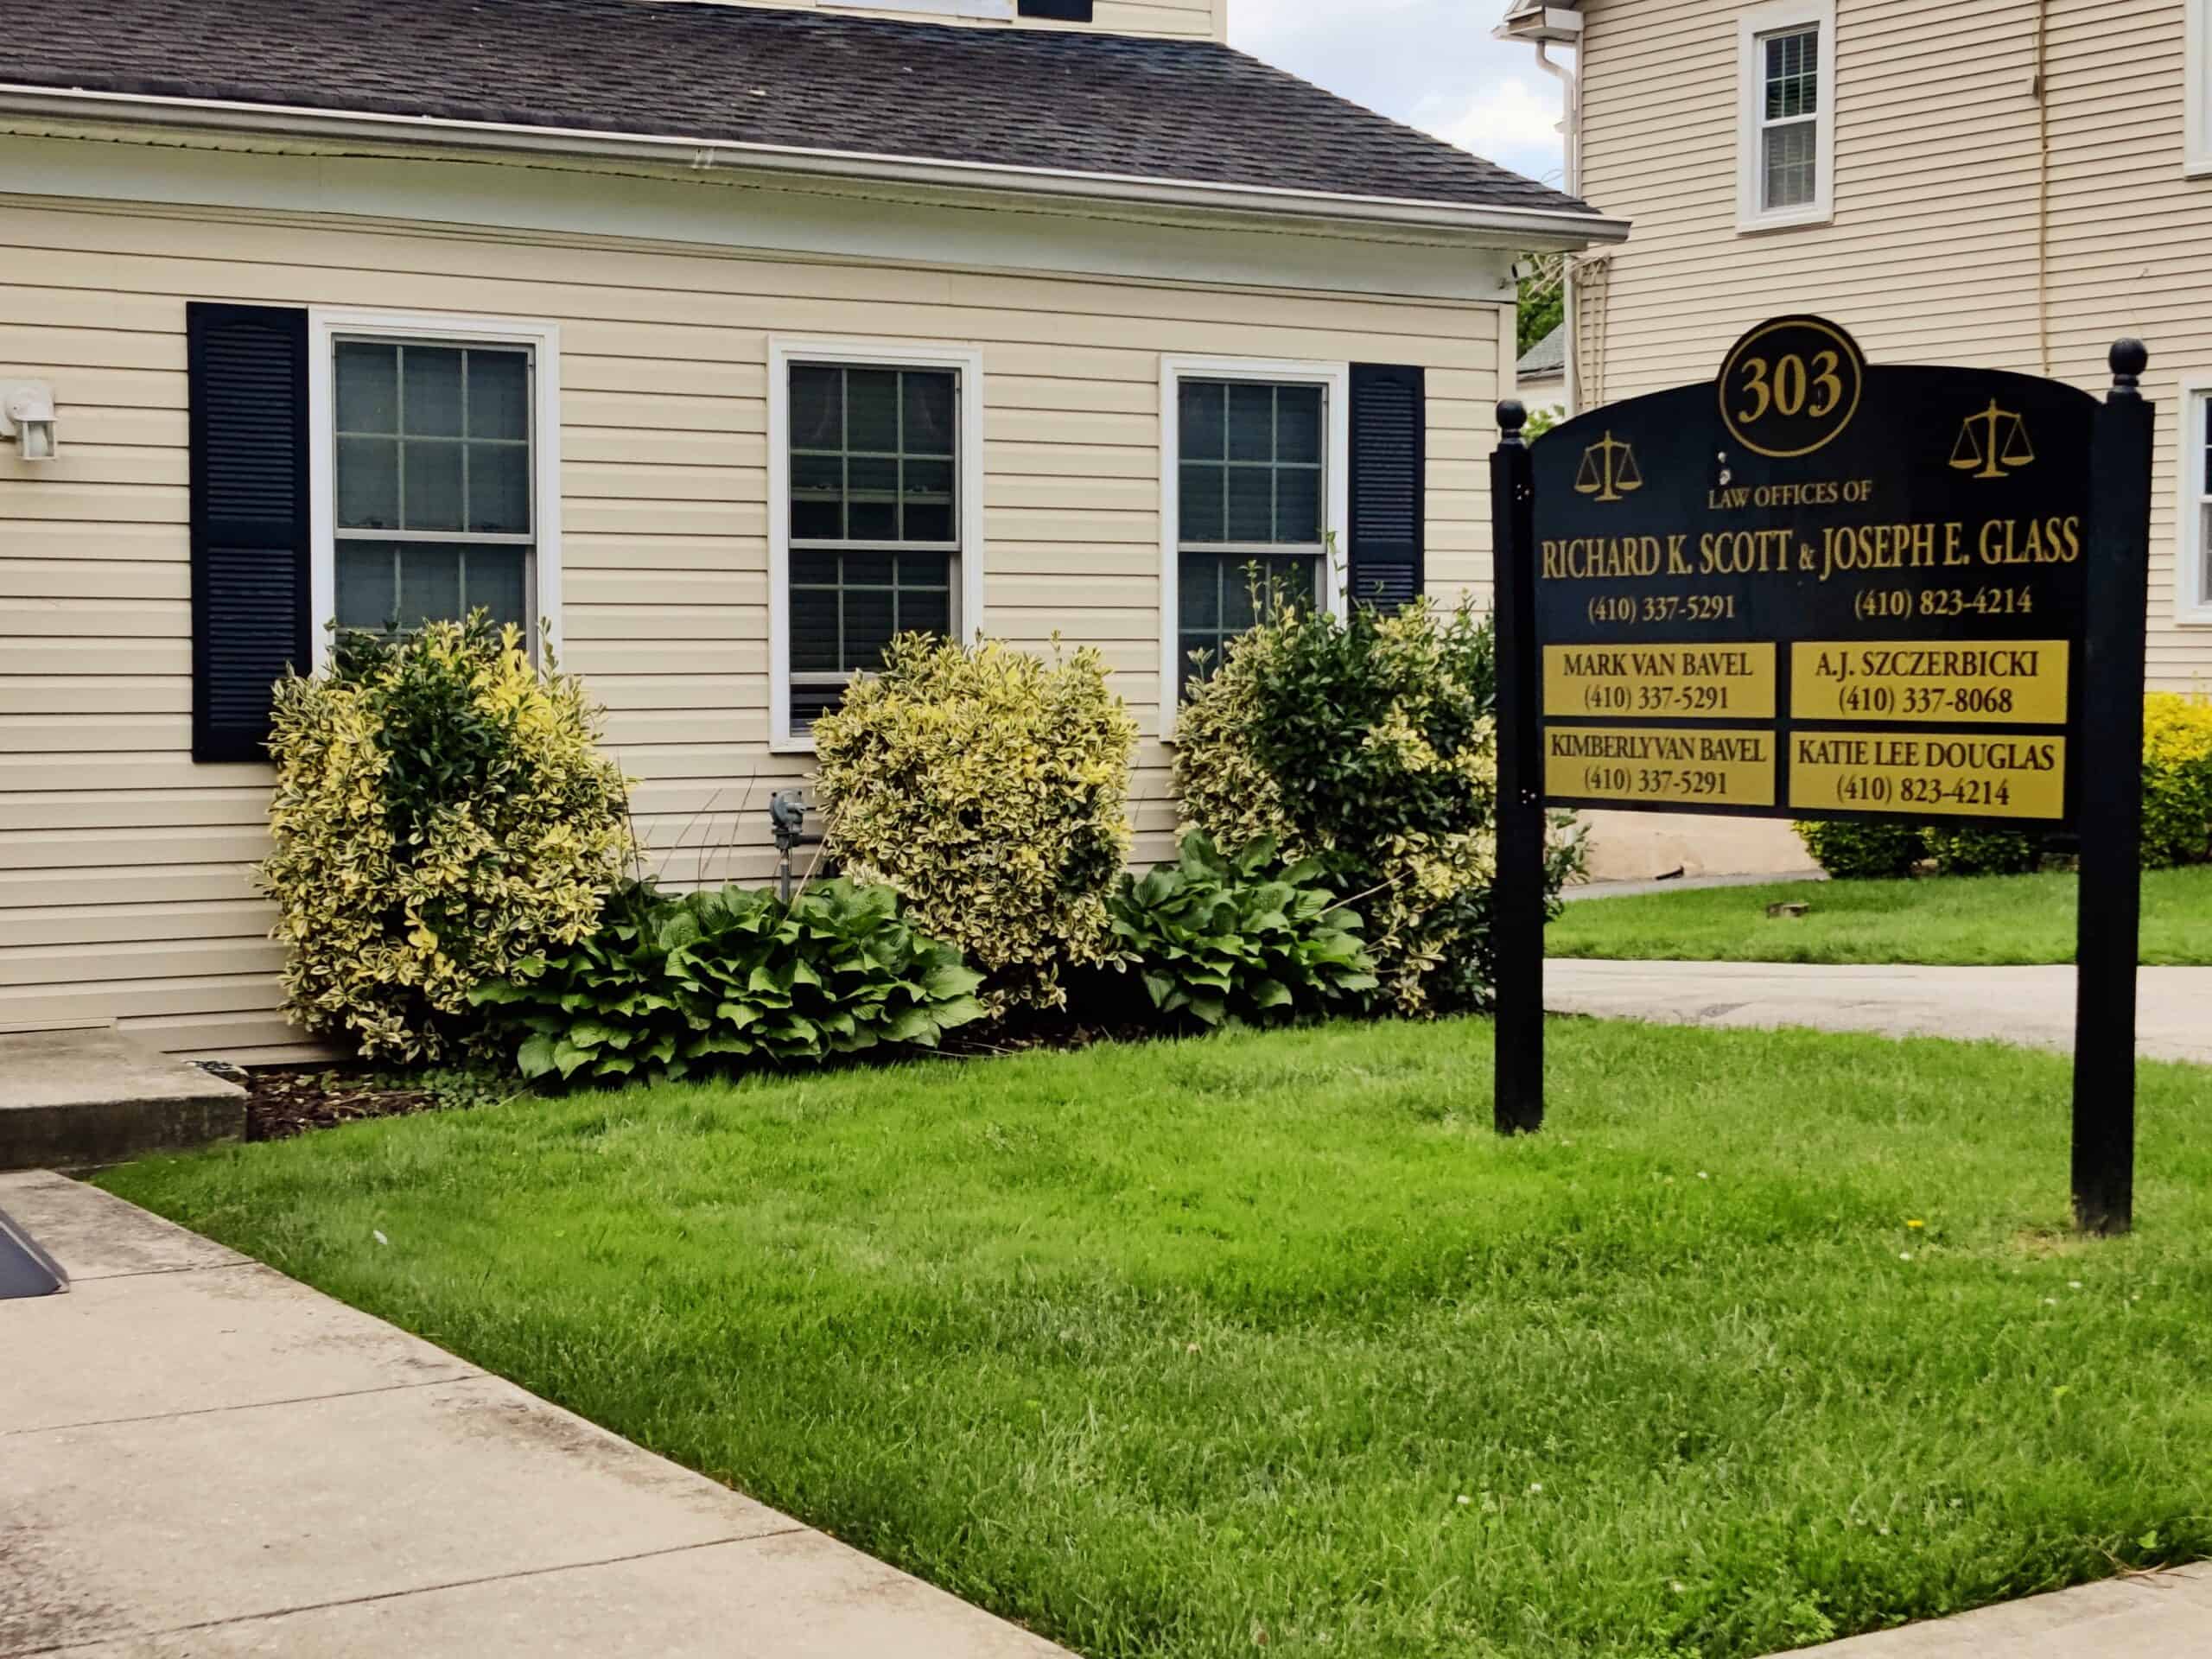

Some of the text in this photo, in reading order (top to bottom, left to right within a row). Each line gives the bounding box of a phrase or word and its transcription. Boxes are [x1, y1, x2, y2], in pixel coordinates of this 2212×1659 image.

[1738, 350, 1842, 423] 303
[1708, 480, 1872, 509] LAW OFFICES OF
[1541, 516, 2080, 581] RICHARD K. SCOTT & JOSEPH E. GLASS
[1587, 594, 1735, 624] (410) 337-5291
[1854, 585, 2032, 620] (410) 823-4214
[1563, 652, 1753, 677] MARK VAN BAVEL
[1815, 651, 2039, 683] A.J. SZCZERBICKI
[1584, 685, 1728, 711] (410) 337-5291
[1839, 685, 2012, 715] (410) 337-8068
[1700, 737, 1767, 762] BAVEL
[1797, 740, 2055, 771] KATIE LEE DOUGLAS
[1584, 766, 1727, 795] (410) 337-5291
[1836, 774, 2010, 805] (410) 823-4214
